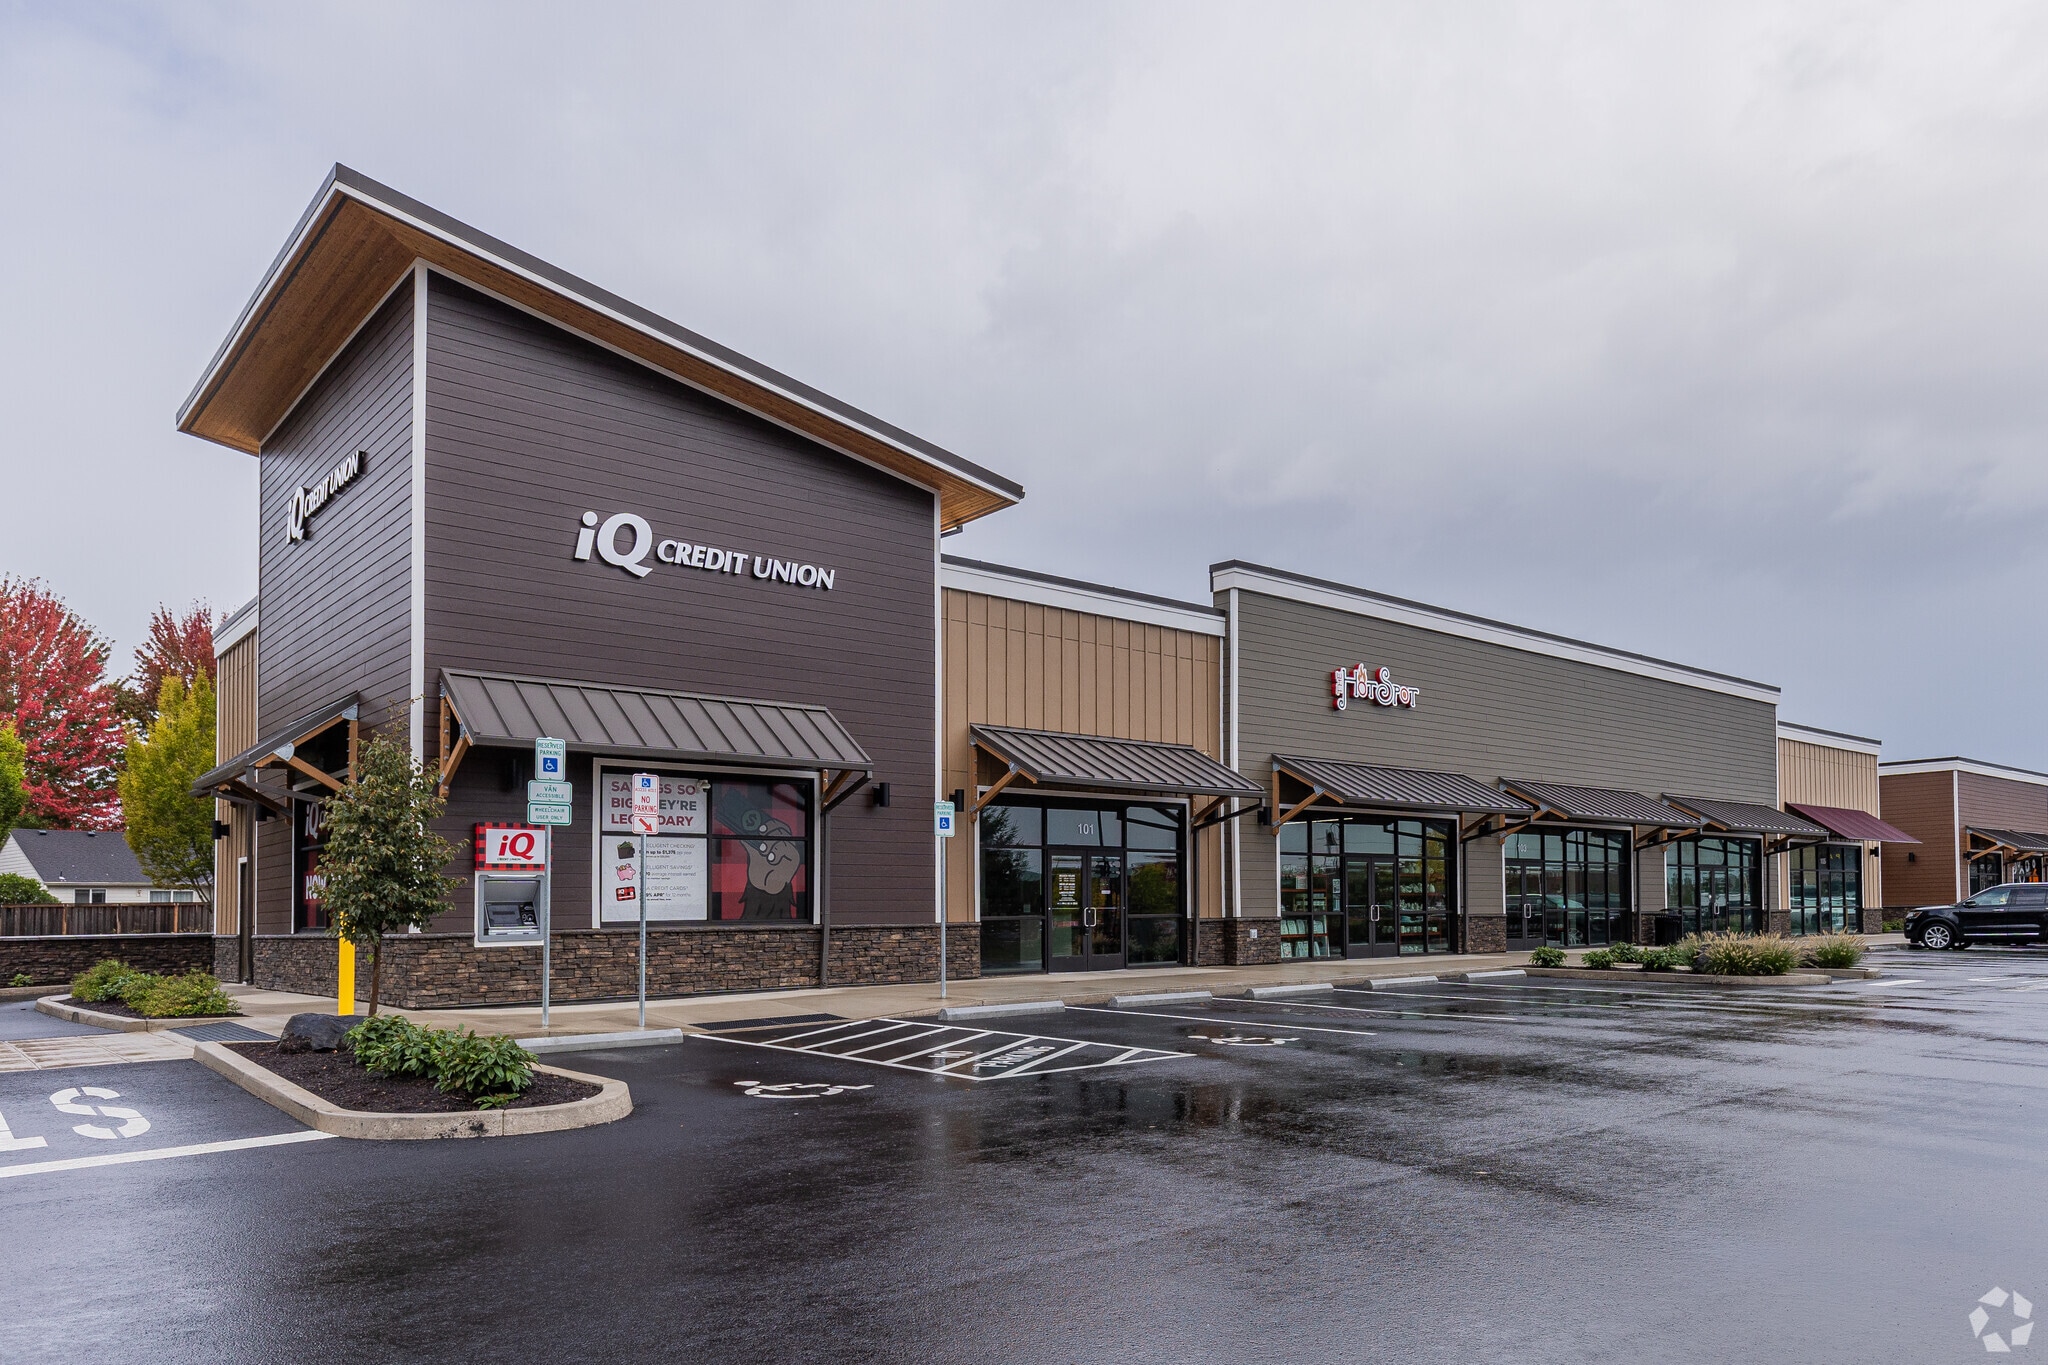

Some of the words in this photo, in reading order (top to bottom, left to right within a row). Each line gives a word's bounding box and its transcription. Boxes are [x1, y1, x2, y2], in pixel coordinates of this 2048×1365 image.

[286, 486, 305, 545] iQ
[304, 476, 330, 518] CREDIT
[329, 450, 360, 495] UNION
[574, 511, 653, 578] iQ
[656, 539, 749, 575] CREDIT
[753, 556, 836, 590] UNION
[537, 742, 564, 750] RESERVED
[677, 783, 697, 796] SO
[634, 804, 657, 813] PARKING
[641, 796, 650, 804] NO
[305, 802, 319, 840] iQ
[1077, 823, 1094, 835] 101
[498, 832, 535, 861] iQ
[972, 1046, 1056, 1068] PARKING
